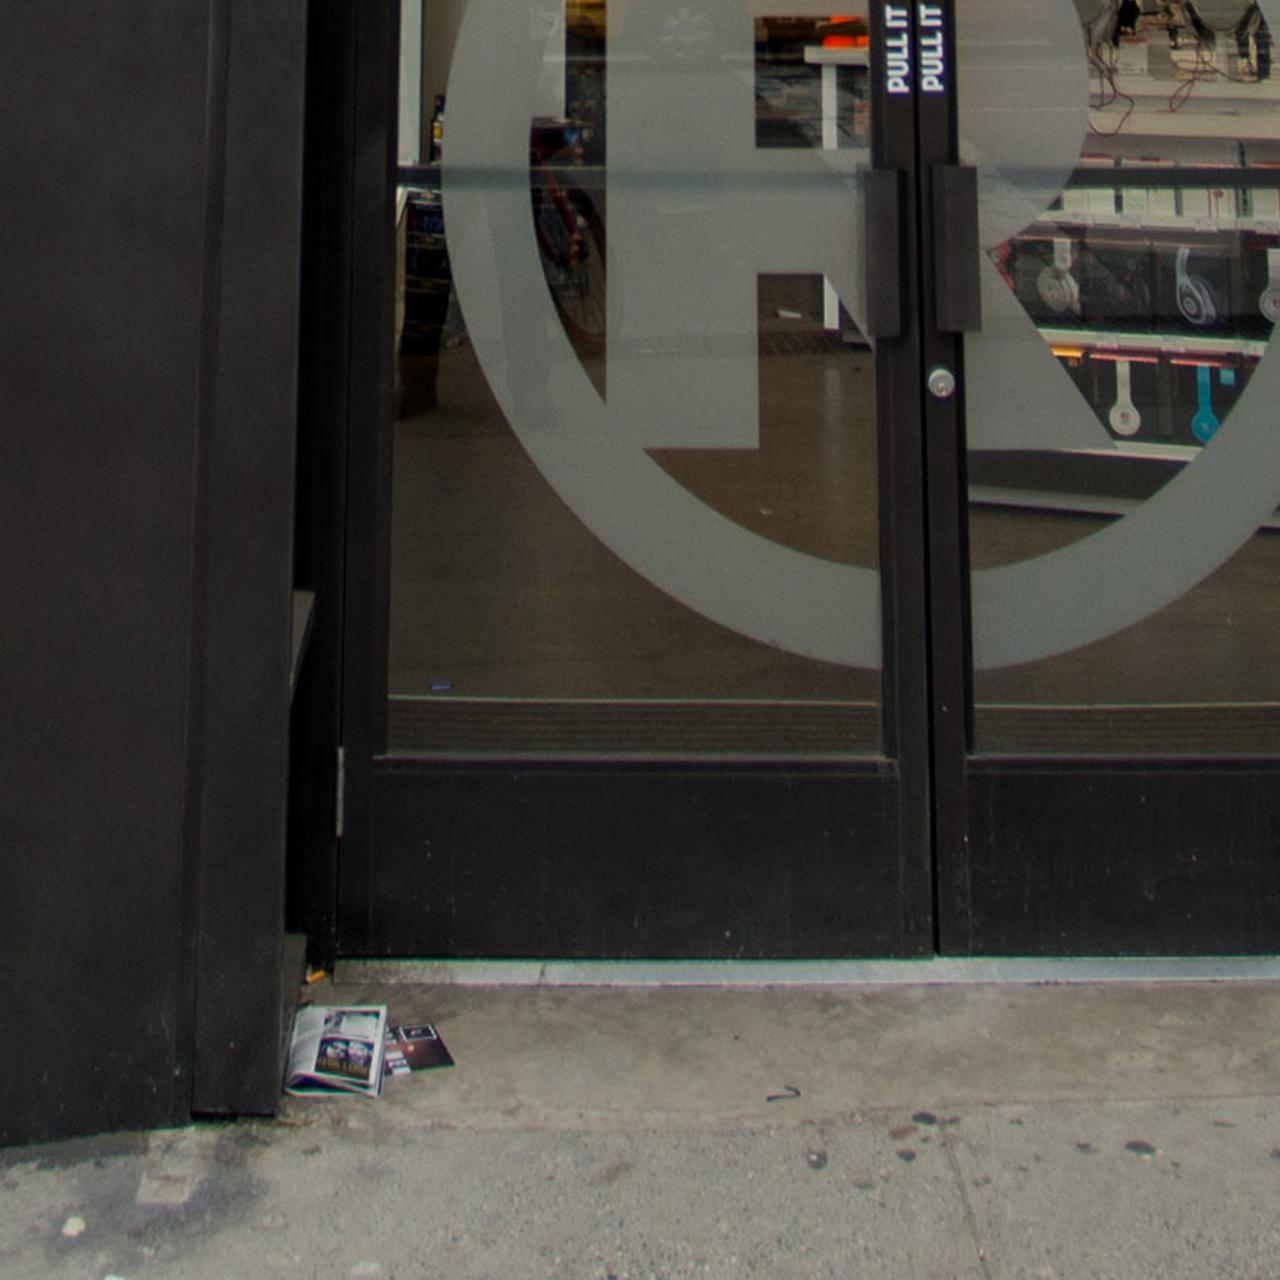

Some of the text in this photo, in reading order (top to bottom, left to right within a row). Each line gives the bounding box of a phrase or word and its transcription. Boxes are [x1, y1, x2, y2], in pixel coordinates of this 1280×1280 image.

[884, 3, 910, 93] PULL IT
[919, 2, 944, 92] PULL IT
